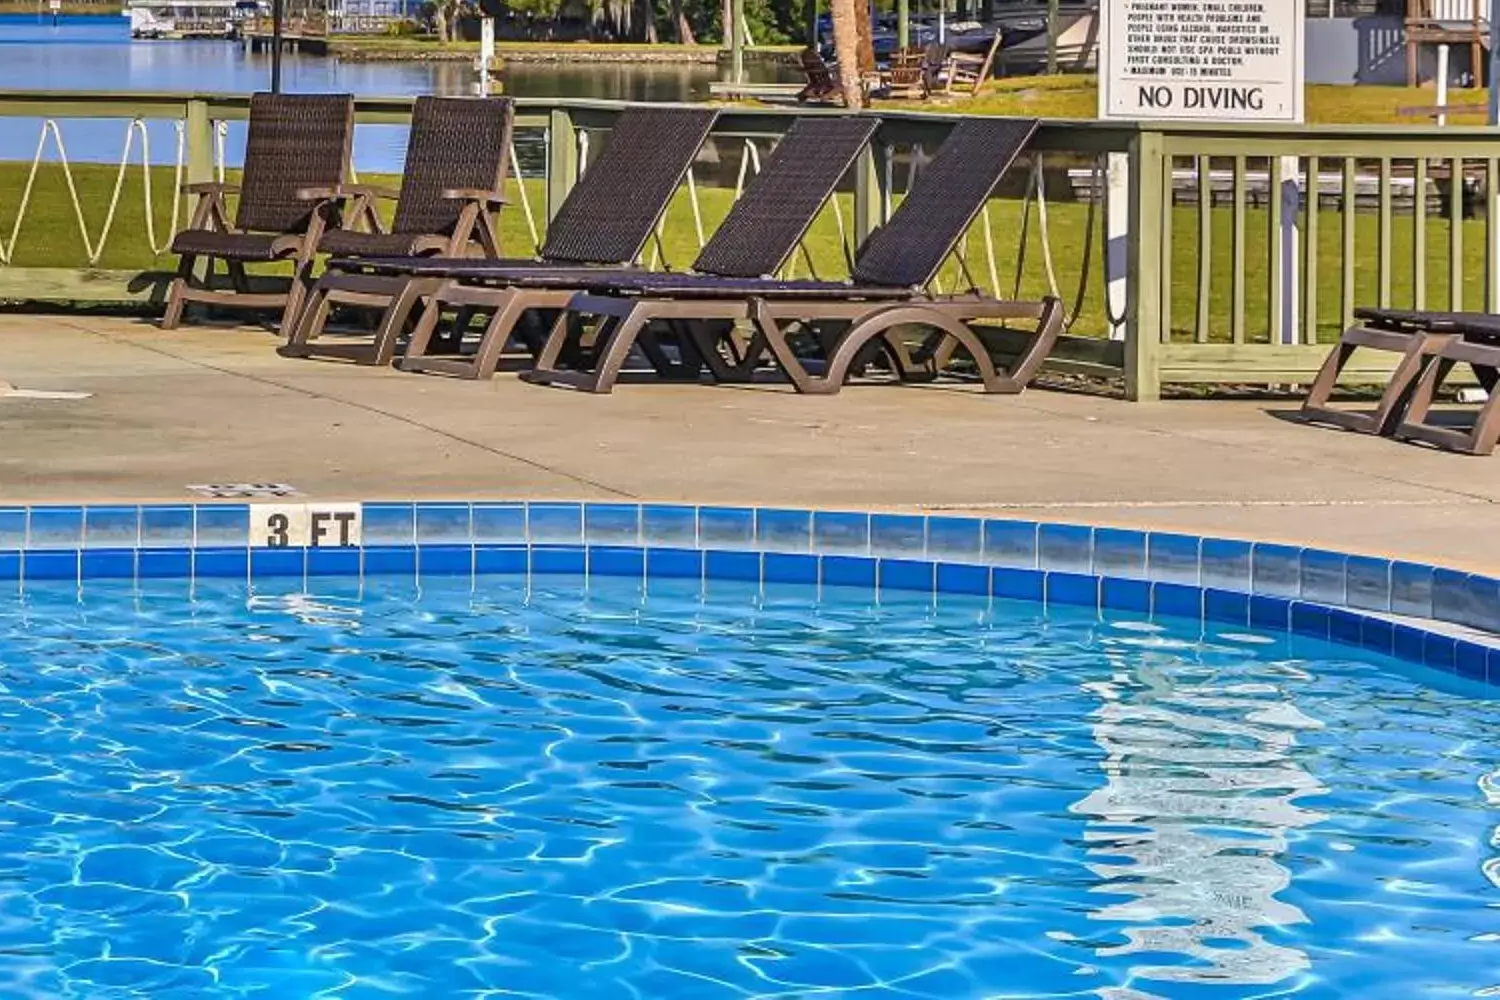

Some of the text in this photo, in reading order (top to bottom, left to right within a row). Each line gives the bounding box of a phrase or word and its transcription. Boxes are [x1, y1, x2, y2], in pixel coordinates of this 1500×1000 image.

[1139, 86, 1263, 110] NO DIVING
[267, 513, 289, 548] 3
